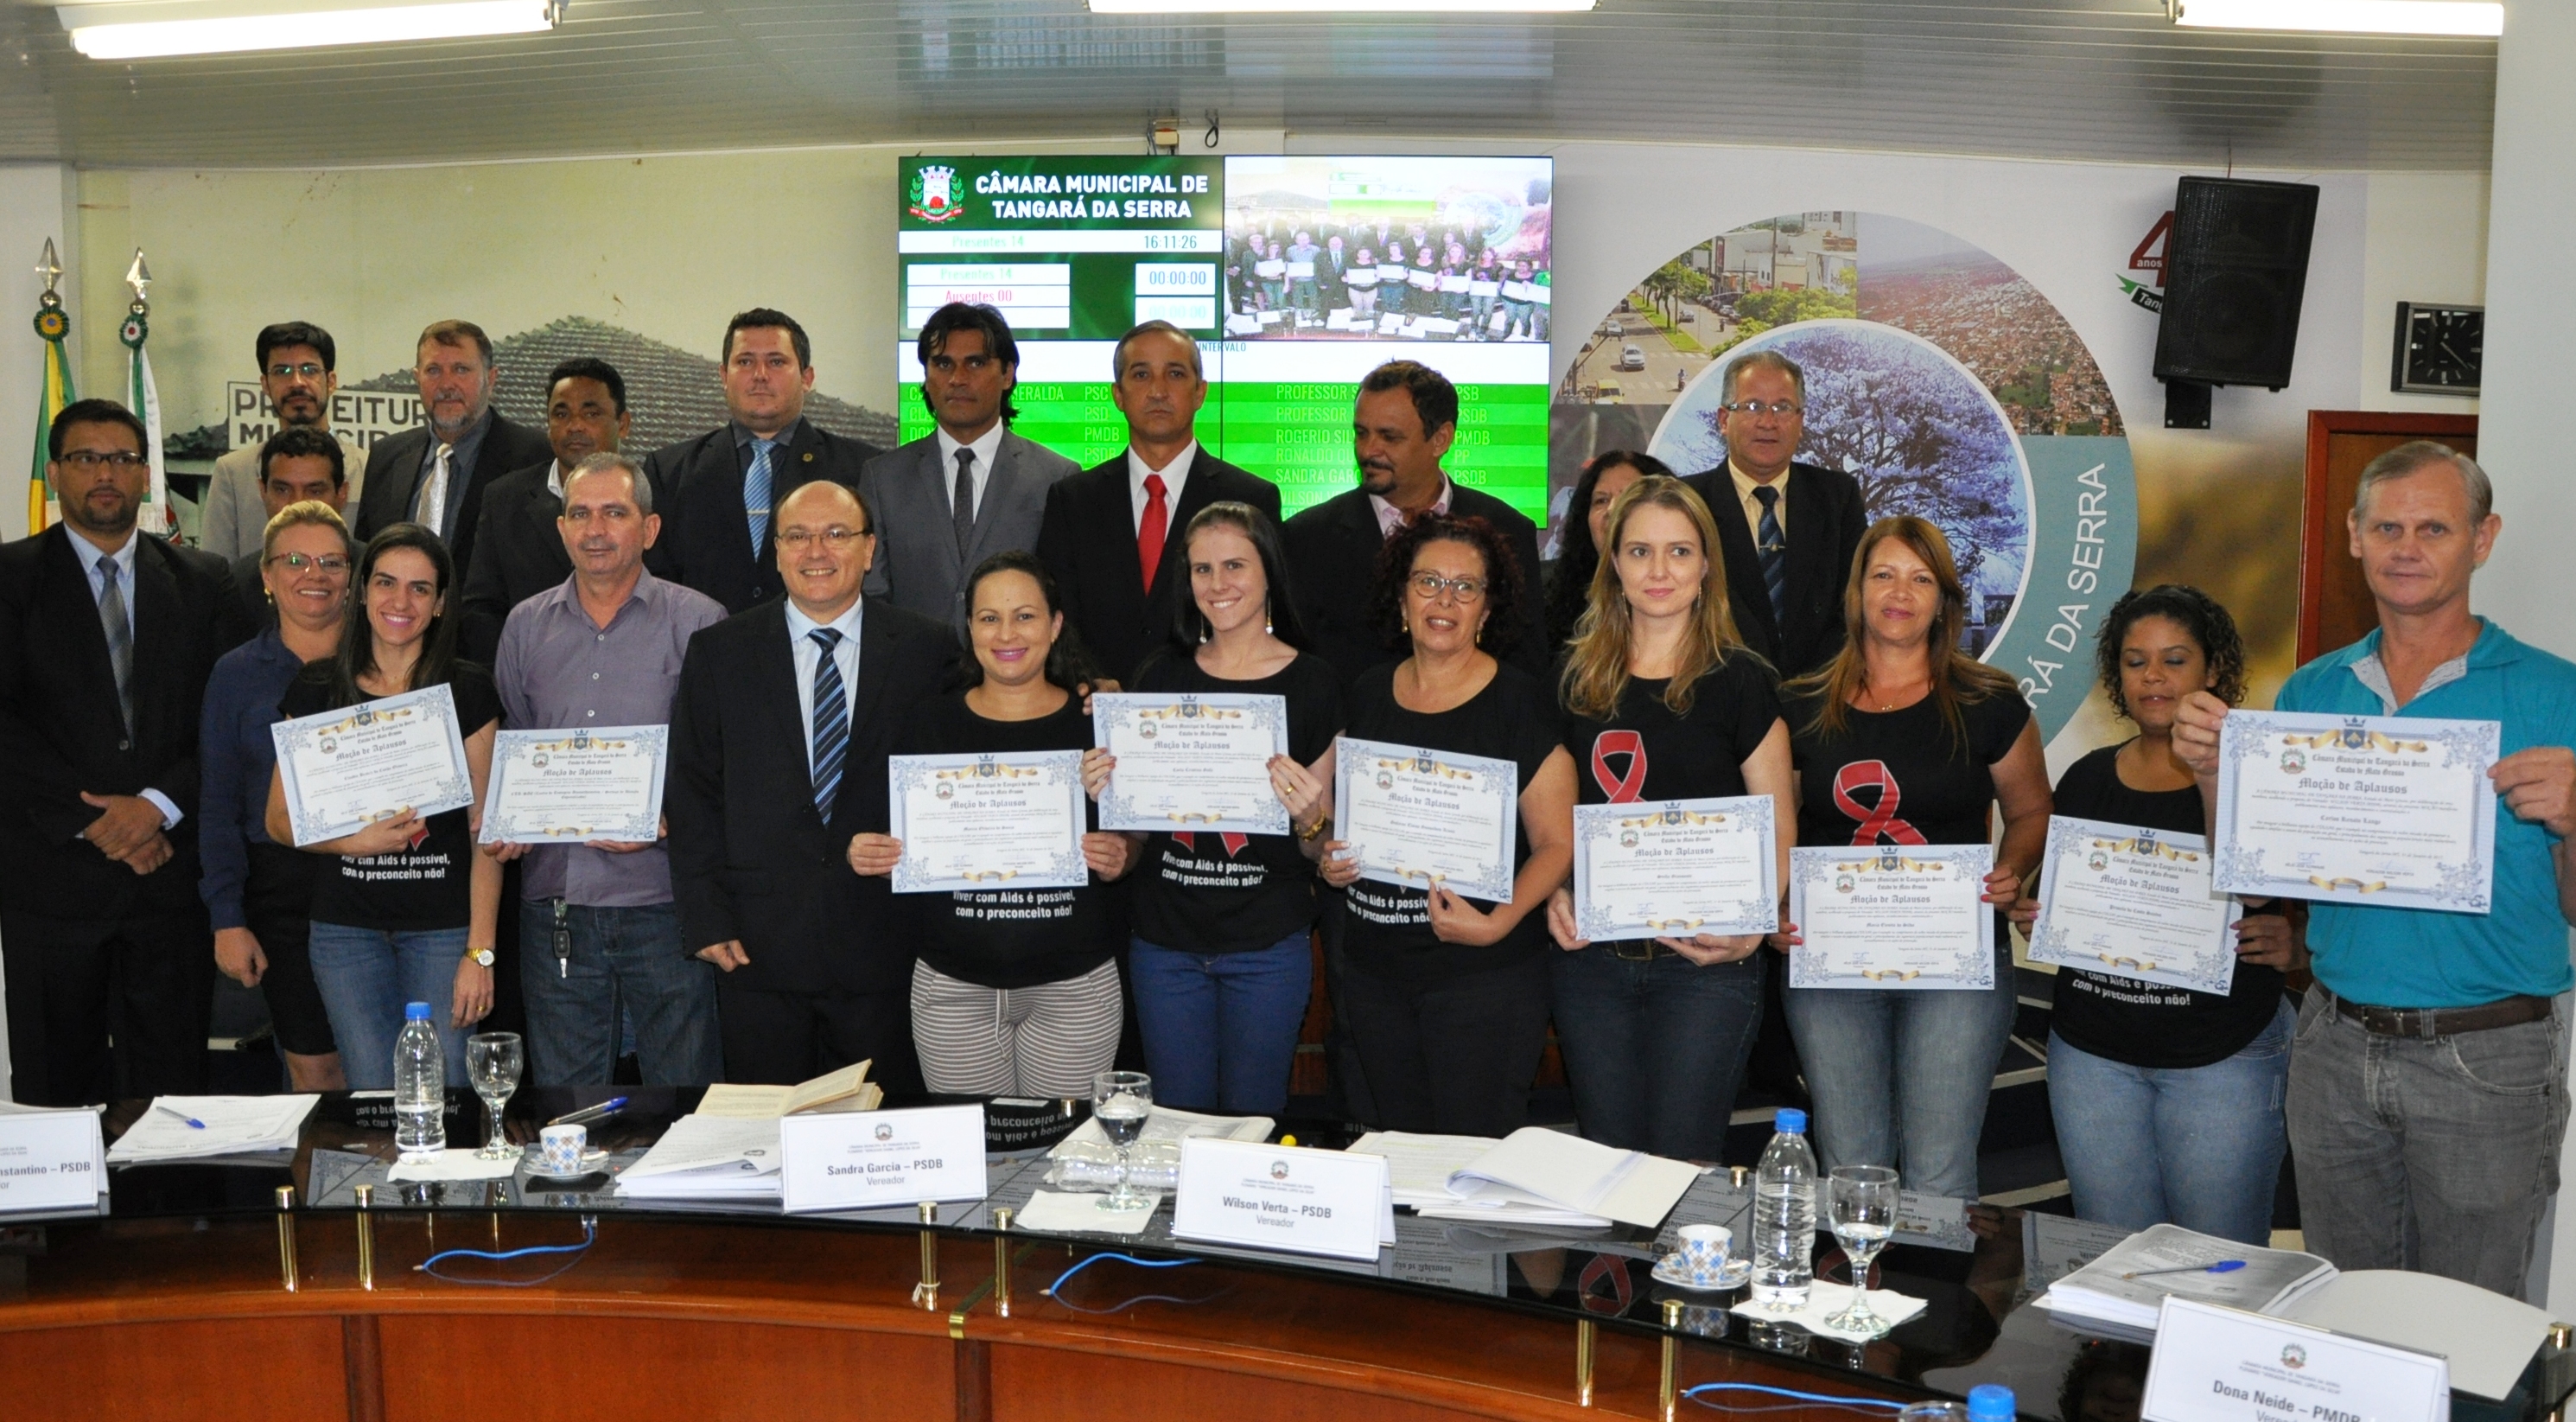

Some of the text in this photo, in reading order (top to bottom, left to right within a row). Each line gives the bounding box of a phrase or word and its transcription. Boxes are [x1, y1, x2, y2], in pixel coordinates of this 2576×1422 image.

[976, 171, 1208, 194] CÂMARA MUNICIPAL DE
[992, 196, 1192, 218] TANGARÁ DA SERRA
[952, 235, 1024, 248] Presentes 14
[1144, 235, 1197, 249] 16:11:26
[1149, 271, 1206, 284] 00:00:00
[945, 290, 995, 303] Ausentes
[1084, 386, 1108, 400] PSC
[1276, 385, 1347, 399] PROFESSOR
[1456, 386, 1479, 401] PSB
[1084, 406, 1108, 421] PSD
[1276, 407, 1347, 422] PROFESSOR
[1084, 427, 1119, 442] PMDB
[1276, 430, 1330, 443] ROGERIO
[1454, 430, 1490, 445] PMDB
[1454, 450, 1470, 463] PP
[1275, 469, 1325, 483] SANDRA
[1454, 469, 1487, 485] PSDB
[2045, 604, 2089, 654] DA
[2067, 463, 2107, 595] SERRA
[2298, 776, 2407, 795] Moção de Aplausos
[1634, 848, 1662, 858] Moção
[1675, 845, 1714, 856] Aplausos
[378, 855, 398, 865] Aids
[401, 854, 407, 864] é
[410, 853, 450, 867] possível,
[1176, 858, 1193, 870] com
[1195, 858, 1215, 871] Aids
[1217, 861, 1224, 872] é
[366, 868, 422, 881] preconceito
[424, 867, 445, 878] não!
[1184, 875, 1239, 886] preconceito
[1242, 875, 1263, 886] não!
[2099, 873, 2128, 887] Moção
[2128, 878, 2138, 887] de
[2140, 879, 2180, 895] Aplausos
[976, 893, 997, 902] com
[1000, 891, 1024, 903] Aids
[1027, 892, 1034, 902] é
[1037, 890, 1076, 905] possível,
[1369, 894, 1386, 908] Aids
[1388, 896, 1394, 909] é
[1396, 896, 1428, 910] possív
[1850, 895, 1877, 904] Moção
[1891, 895, 1930, 903] Aplausos
[956, 904, 1072, 921] com o preconceito não!
[1363, 909, 1409, 924] preconceito
[2088, 971, 2107, 983] com
[2110, 975, 2131, 988] Aids
[2072, 979, 2092, 992] com
[2102, 988, 2161, 1004] preconceito
[2165, 993, 2191, 1005] não!
[0, 1162, 91, 1176] nstantino PSDB
[828, 1158, 943, 1176] Sandra Garcia PSDB
[867, 1176, 906, 1186] Vereador
[1223, 1196, 1332, 1218] Wilson Verta PSDB
[1256, 1215, 1294, 1228] Vereador
[2213, 1380, 2248, 1400] Dona
[2253, 1390, 2295, 1412] Neide
